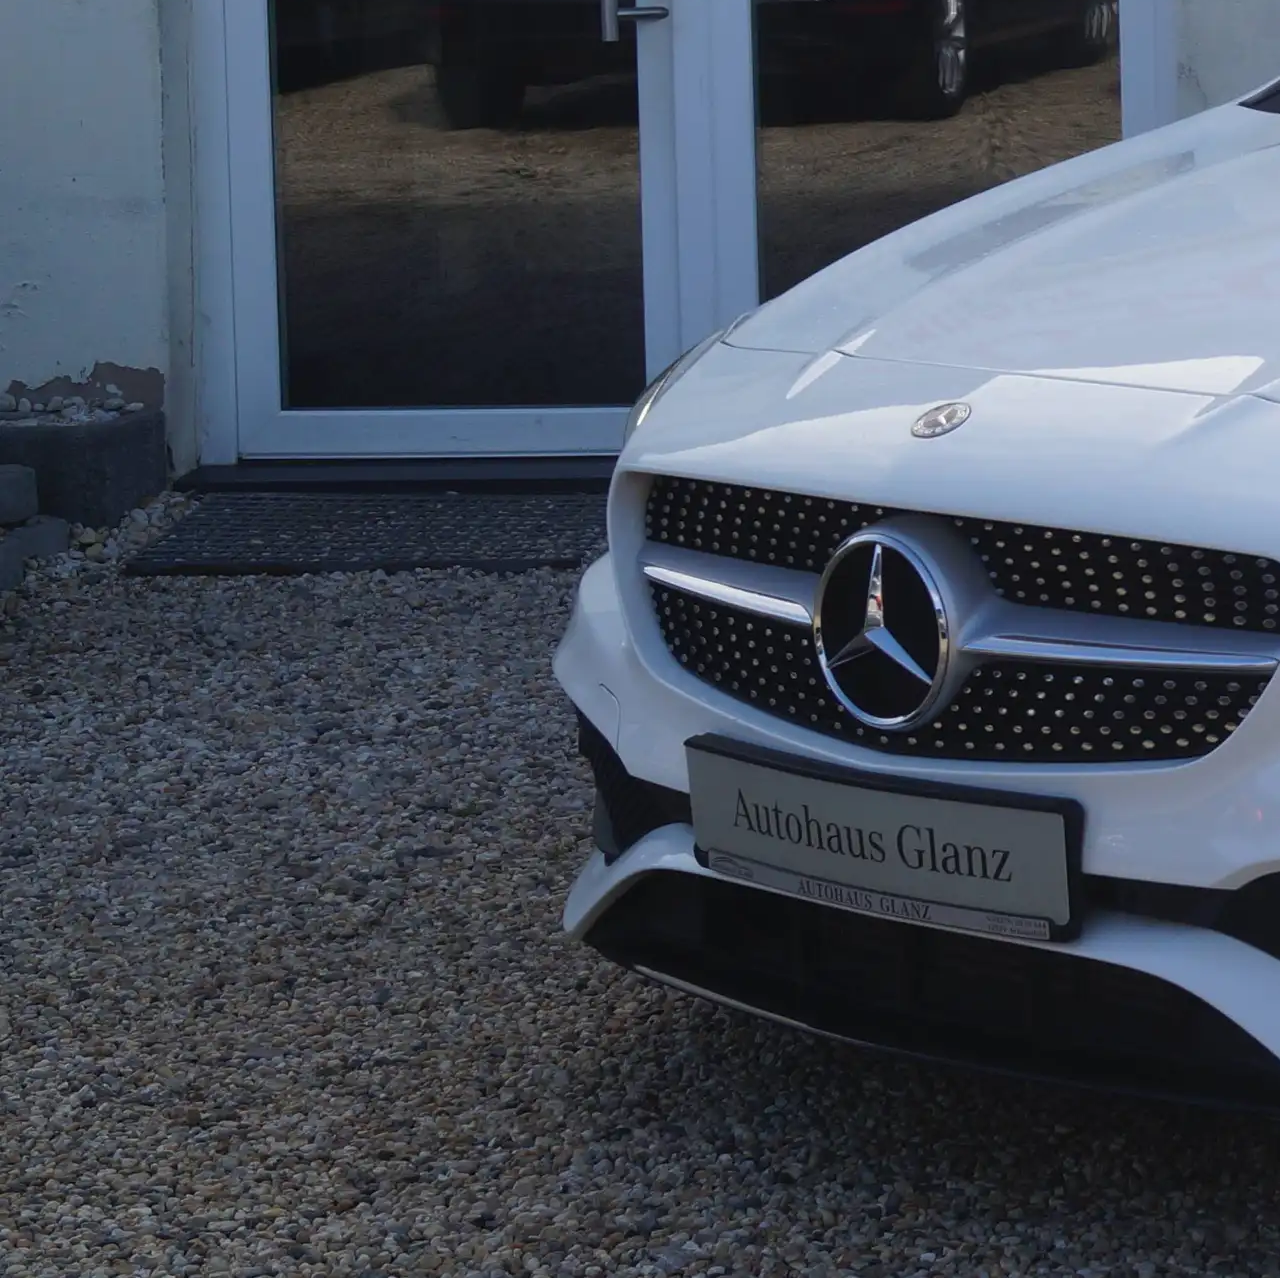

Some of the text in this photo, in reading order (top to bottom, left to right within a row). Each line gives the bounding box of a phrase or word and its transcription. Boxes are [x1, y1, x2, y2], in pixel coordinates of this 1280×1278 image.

[733, 788, 1014, 884] Autohaus Glanz
[797, 877, 932, 921] AUTOHAUS GLANZ
